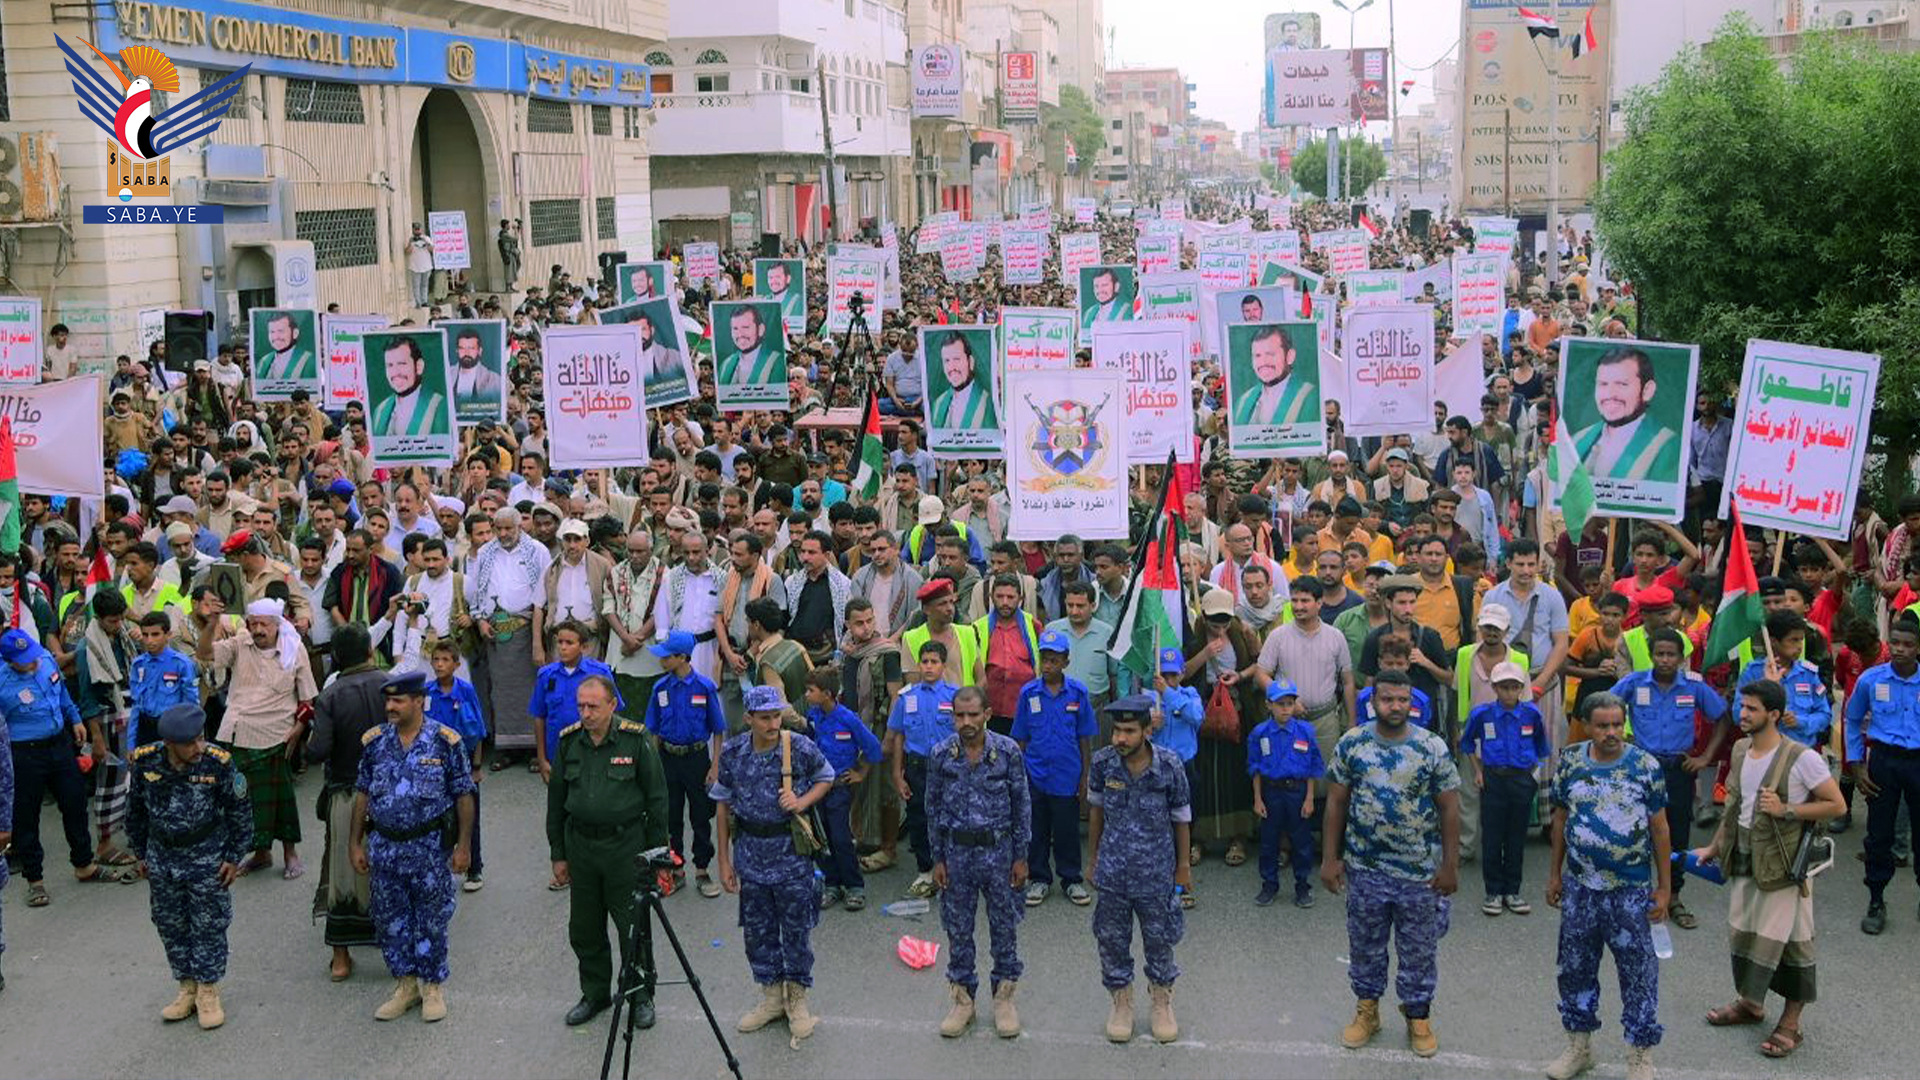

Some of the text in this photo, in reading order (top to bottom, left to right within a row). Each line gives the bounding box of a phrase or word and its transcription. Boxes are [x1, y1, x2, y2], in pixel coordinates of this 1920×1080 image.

[117, 2, 398, 68] YEMEN COMMERCIAL BANK
[1283, 64, 1329, 82] هيهات
[1474, 154, 1503, 166] SMS
[1470, 185, 1504, 195] PHON
[1007, 319, 1069, 343] الله أكبر
[1756, 363, 1852, 408] قاطعوا
[1745, 410, 1854, 453] البضائع الأمريكية
[1786, 448, 1797, 474] و
[1736, 474, 1844, 521] الإسرائيلية
